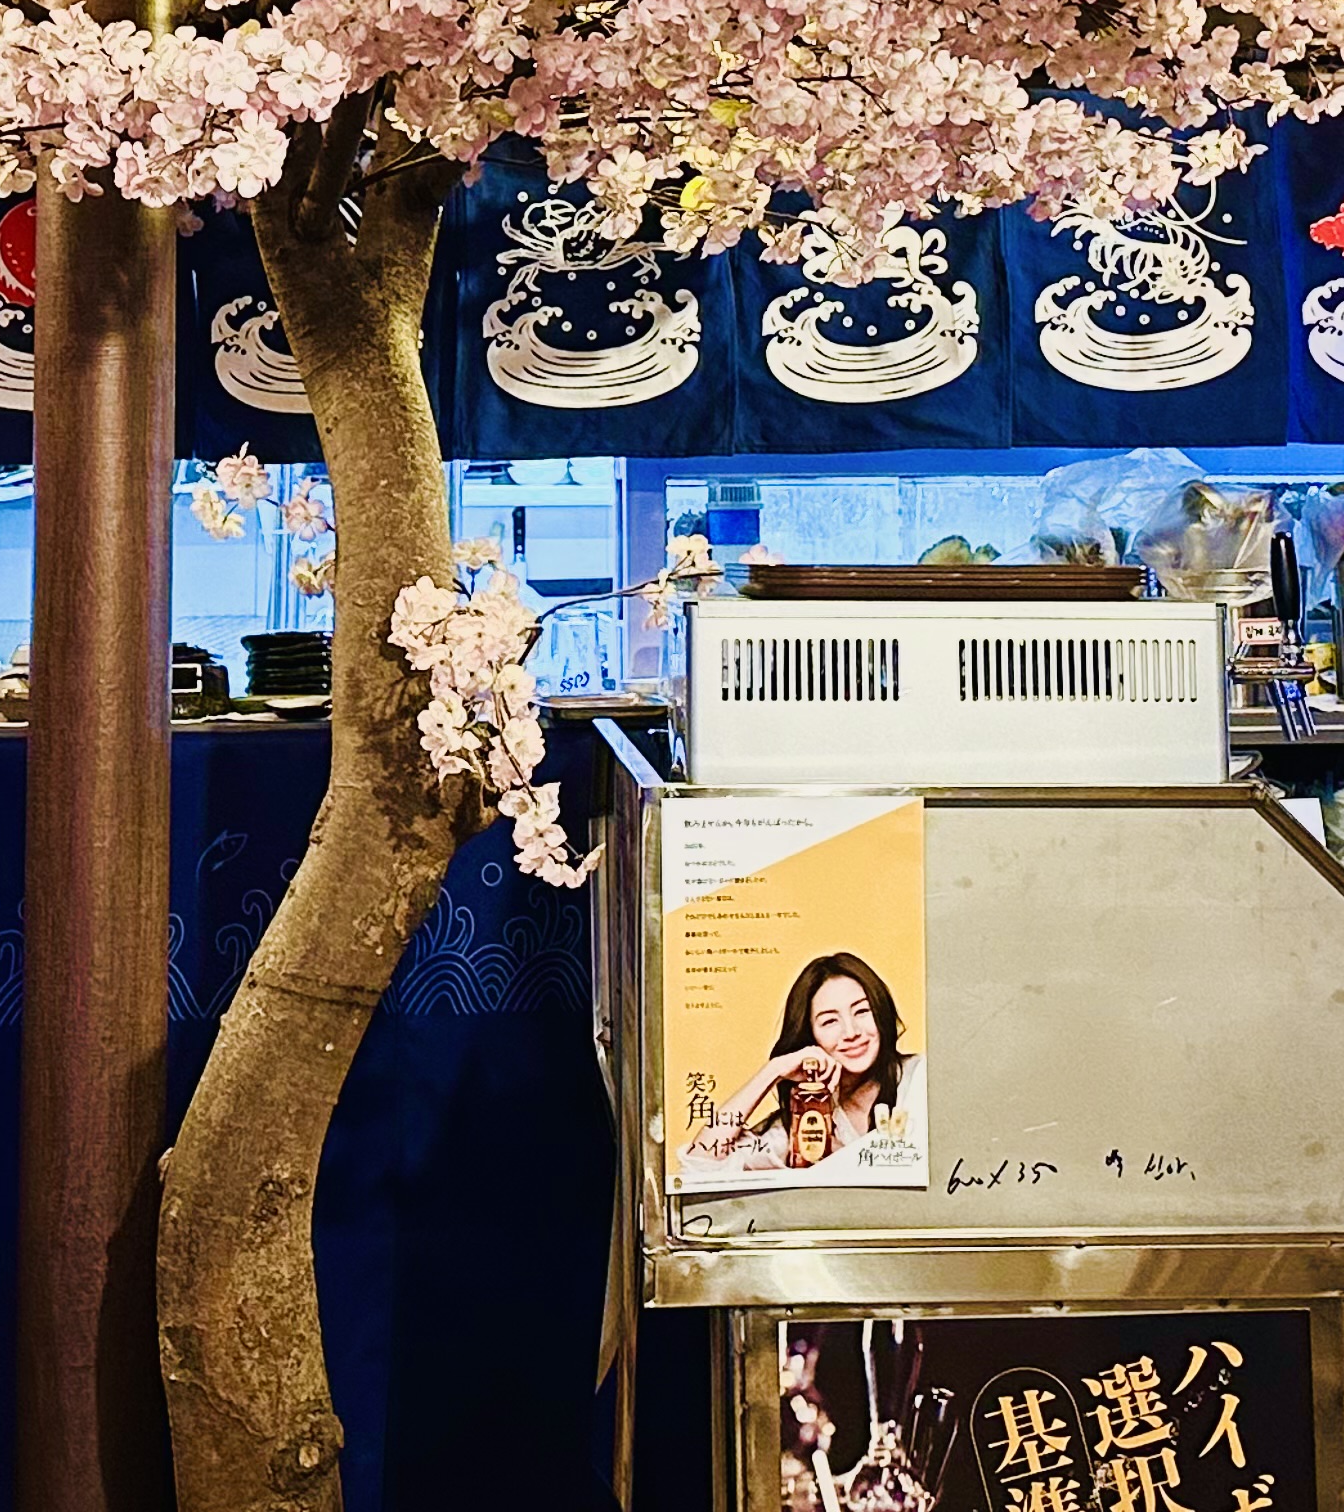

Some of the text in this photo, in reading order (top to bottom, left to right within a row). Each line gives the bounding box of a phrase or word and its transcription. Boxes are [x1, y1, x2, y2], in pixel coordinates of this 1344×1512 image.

[685, 1071, 717, 1094] 笑う
[685, 1137, 771, 1158] ハイボール。
